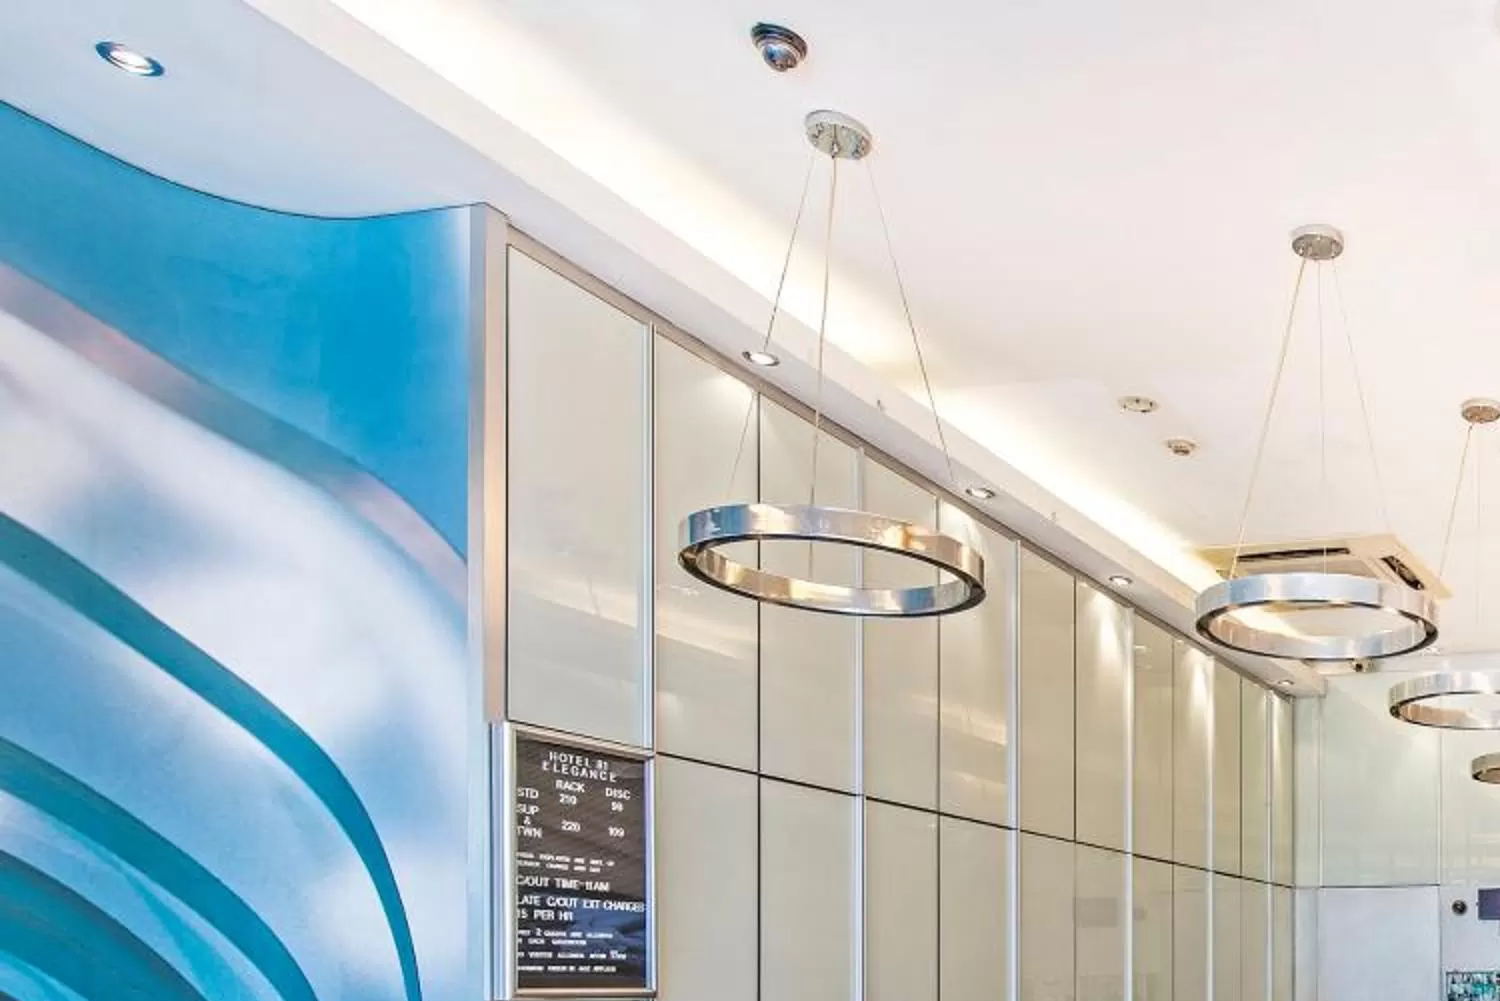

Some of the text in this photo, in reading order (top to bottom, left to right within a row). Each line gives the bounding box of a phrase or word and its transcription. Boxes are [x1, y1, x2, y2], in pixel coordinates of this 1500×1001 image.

[549, 751, 590, 768] HOTEL
[542, 760, 617, 783] ELEGANCE
[517, 787, 539, 799] STD
[555, 779, 631, 800] RACK DISC
[534, 910, 554, 921] PER
